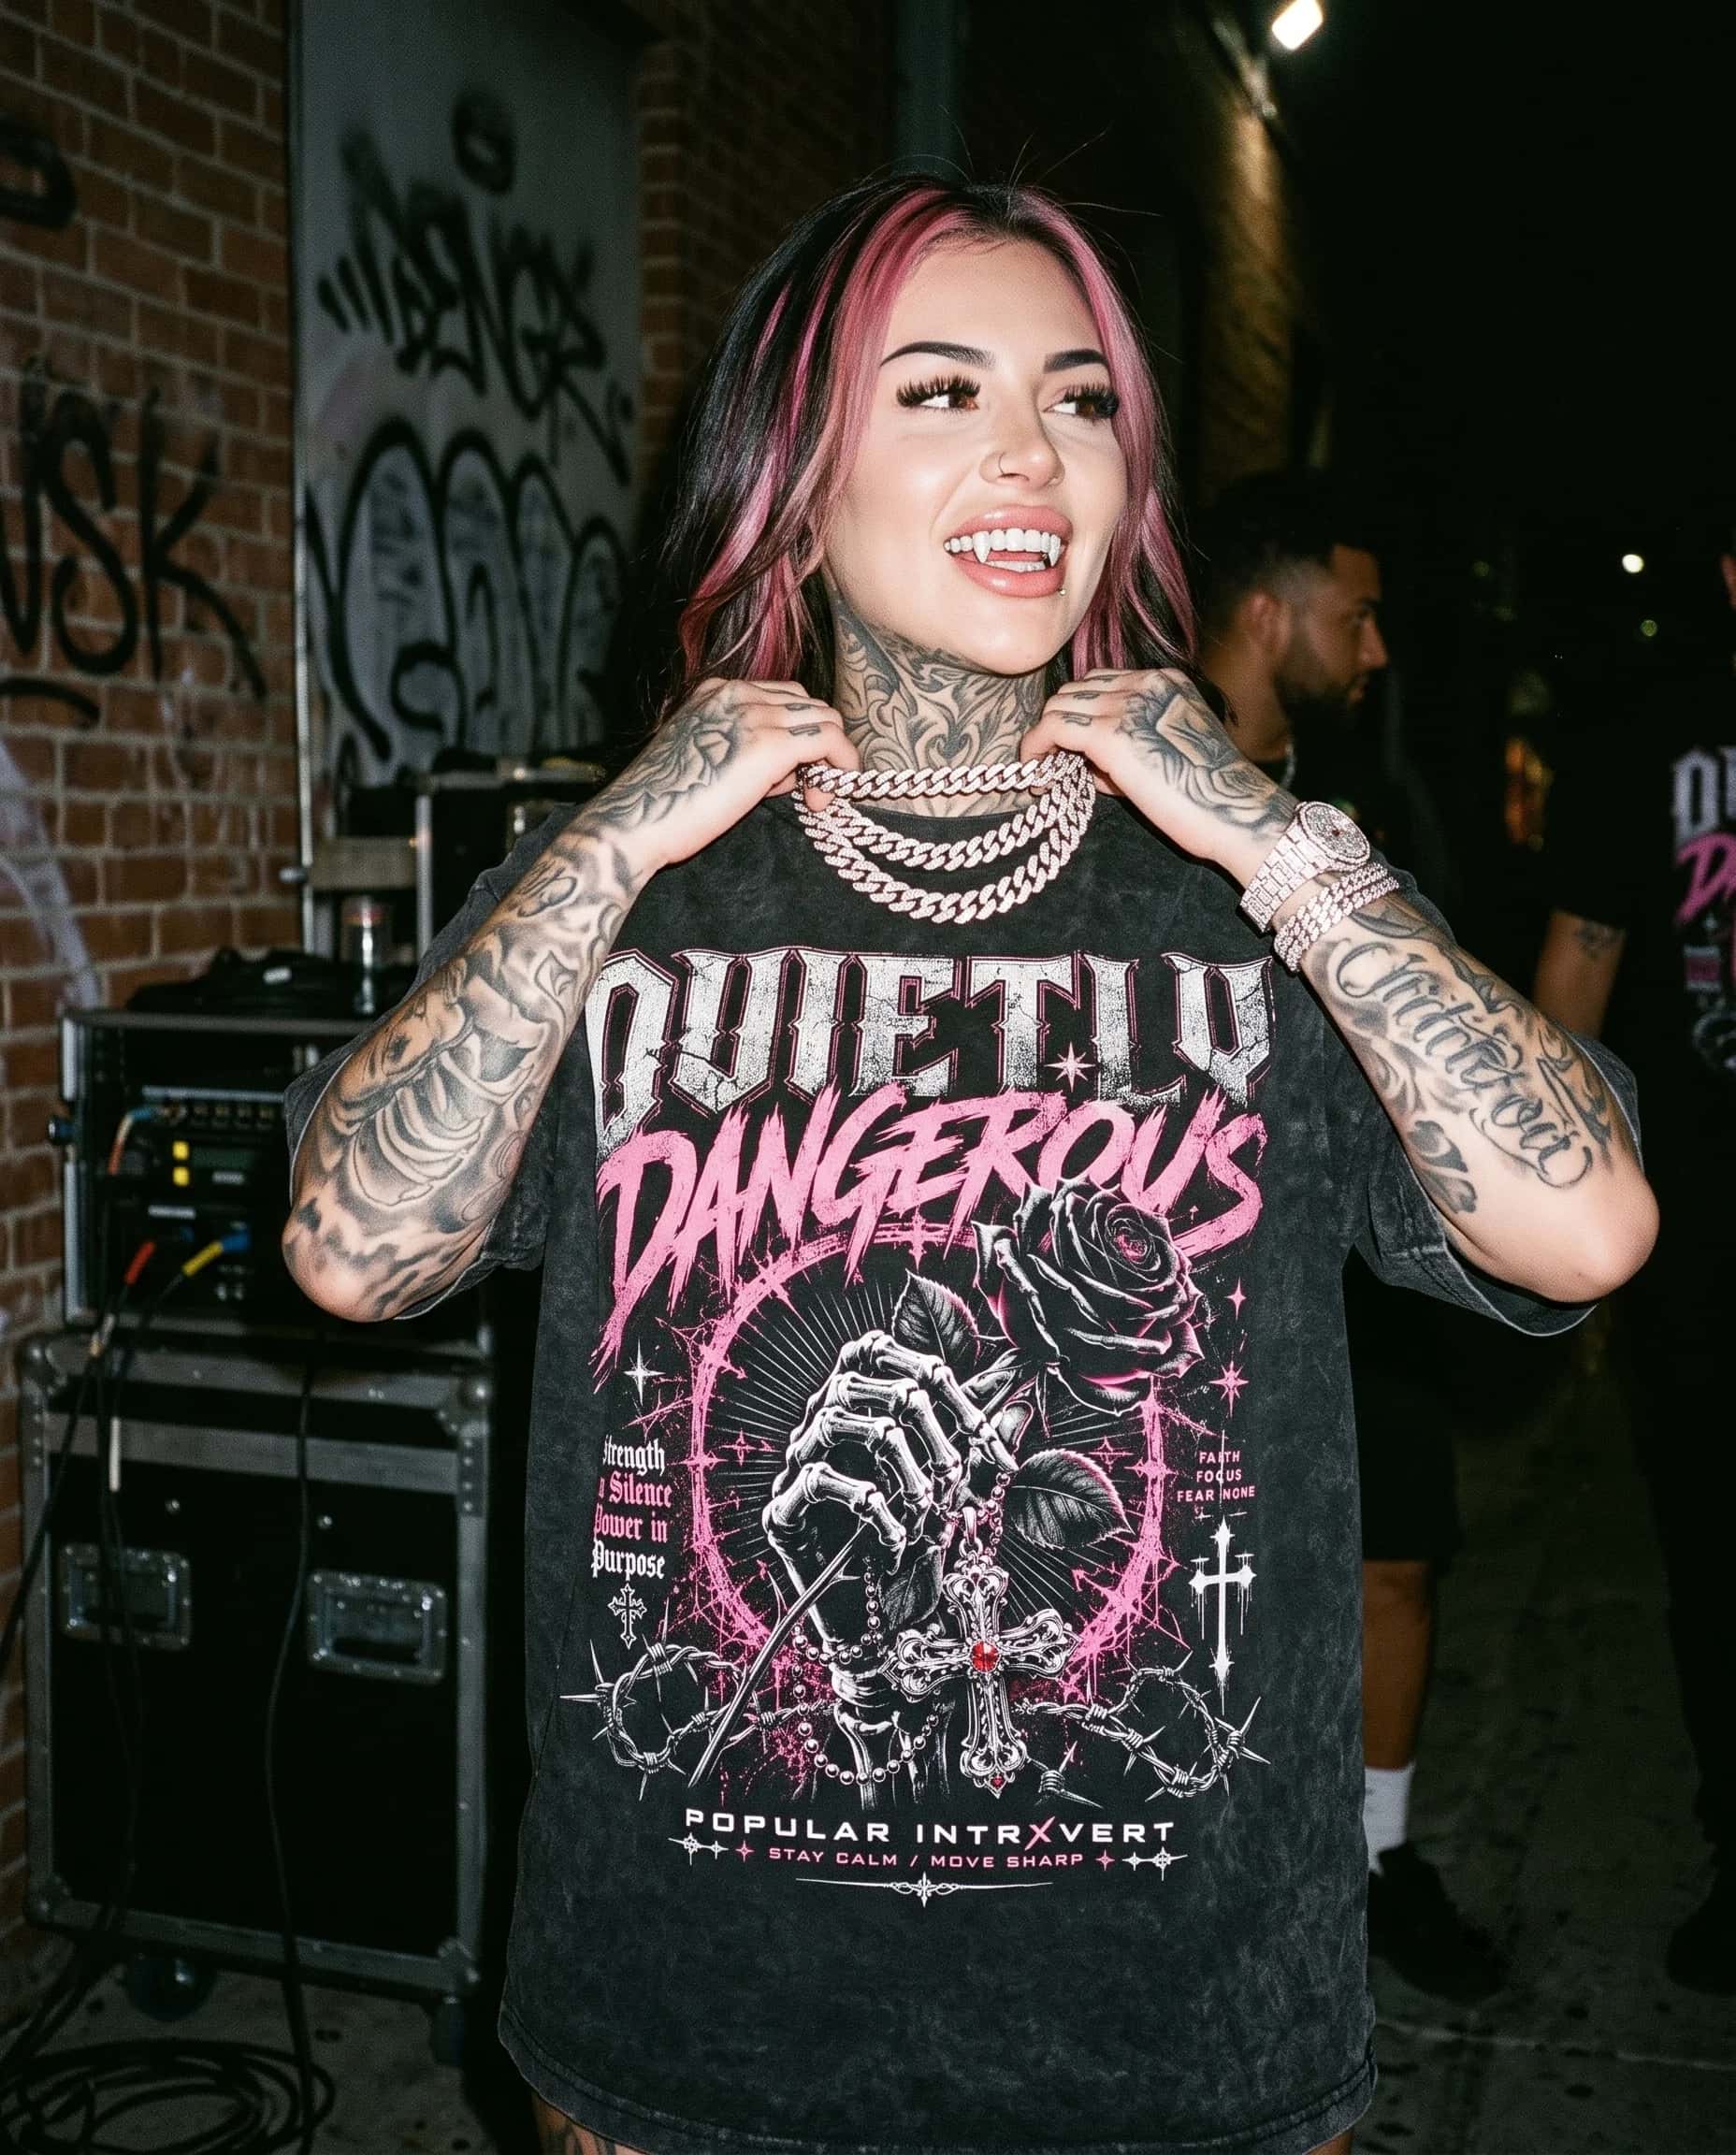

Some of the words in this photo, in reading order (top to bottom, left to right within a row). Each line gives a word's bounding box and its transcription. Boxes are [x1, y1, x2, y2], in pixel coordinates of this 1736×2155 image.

[585, 947, 1275, 1160] QUIETLY
[588, 1074, 1268, 1380] DANGEROUS
[1198, 1450, 1240, 1464] FAITH
[609, 1470, 673, 1508] Silence
[1196, 1468, 1242, 1482] FOCUS
[1177, 1489, 1214, 1502] FEAR
[1222, 1485, 1255, 1500] NONE
[651, 1511, 668, 1543] in
[591, 1539, 666, 1582] Purpose
[686, 1808, 890, 1843] POPULAR
[917, 1816, 1174, 1851] INTRXVERT
[769, 1847, 824, 1862] STAY
[836, 1852, 897, 1866] CALM
[931, 1855, 994, 1868] MOVE
[1006, 1854, 1083, 1868] SHARP
